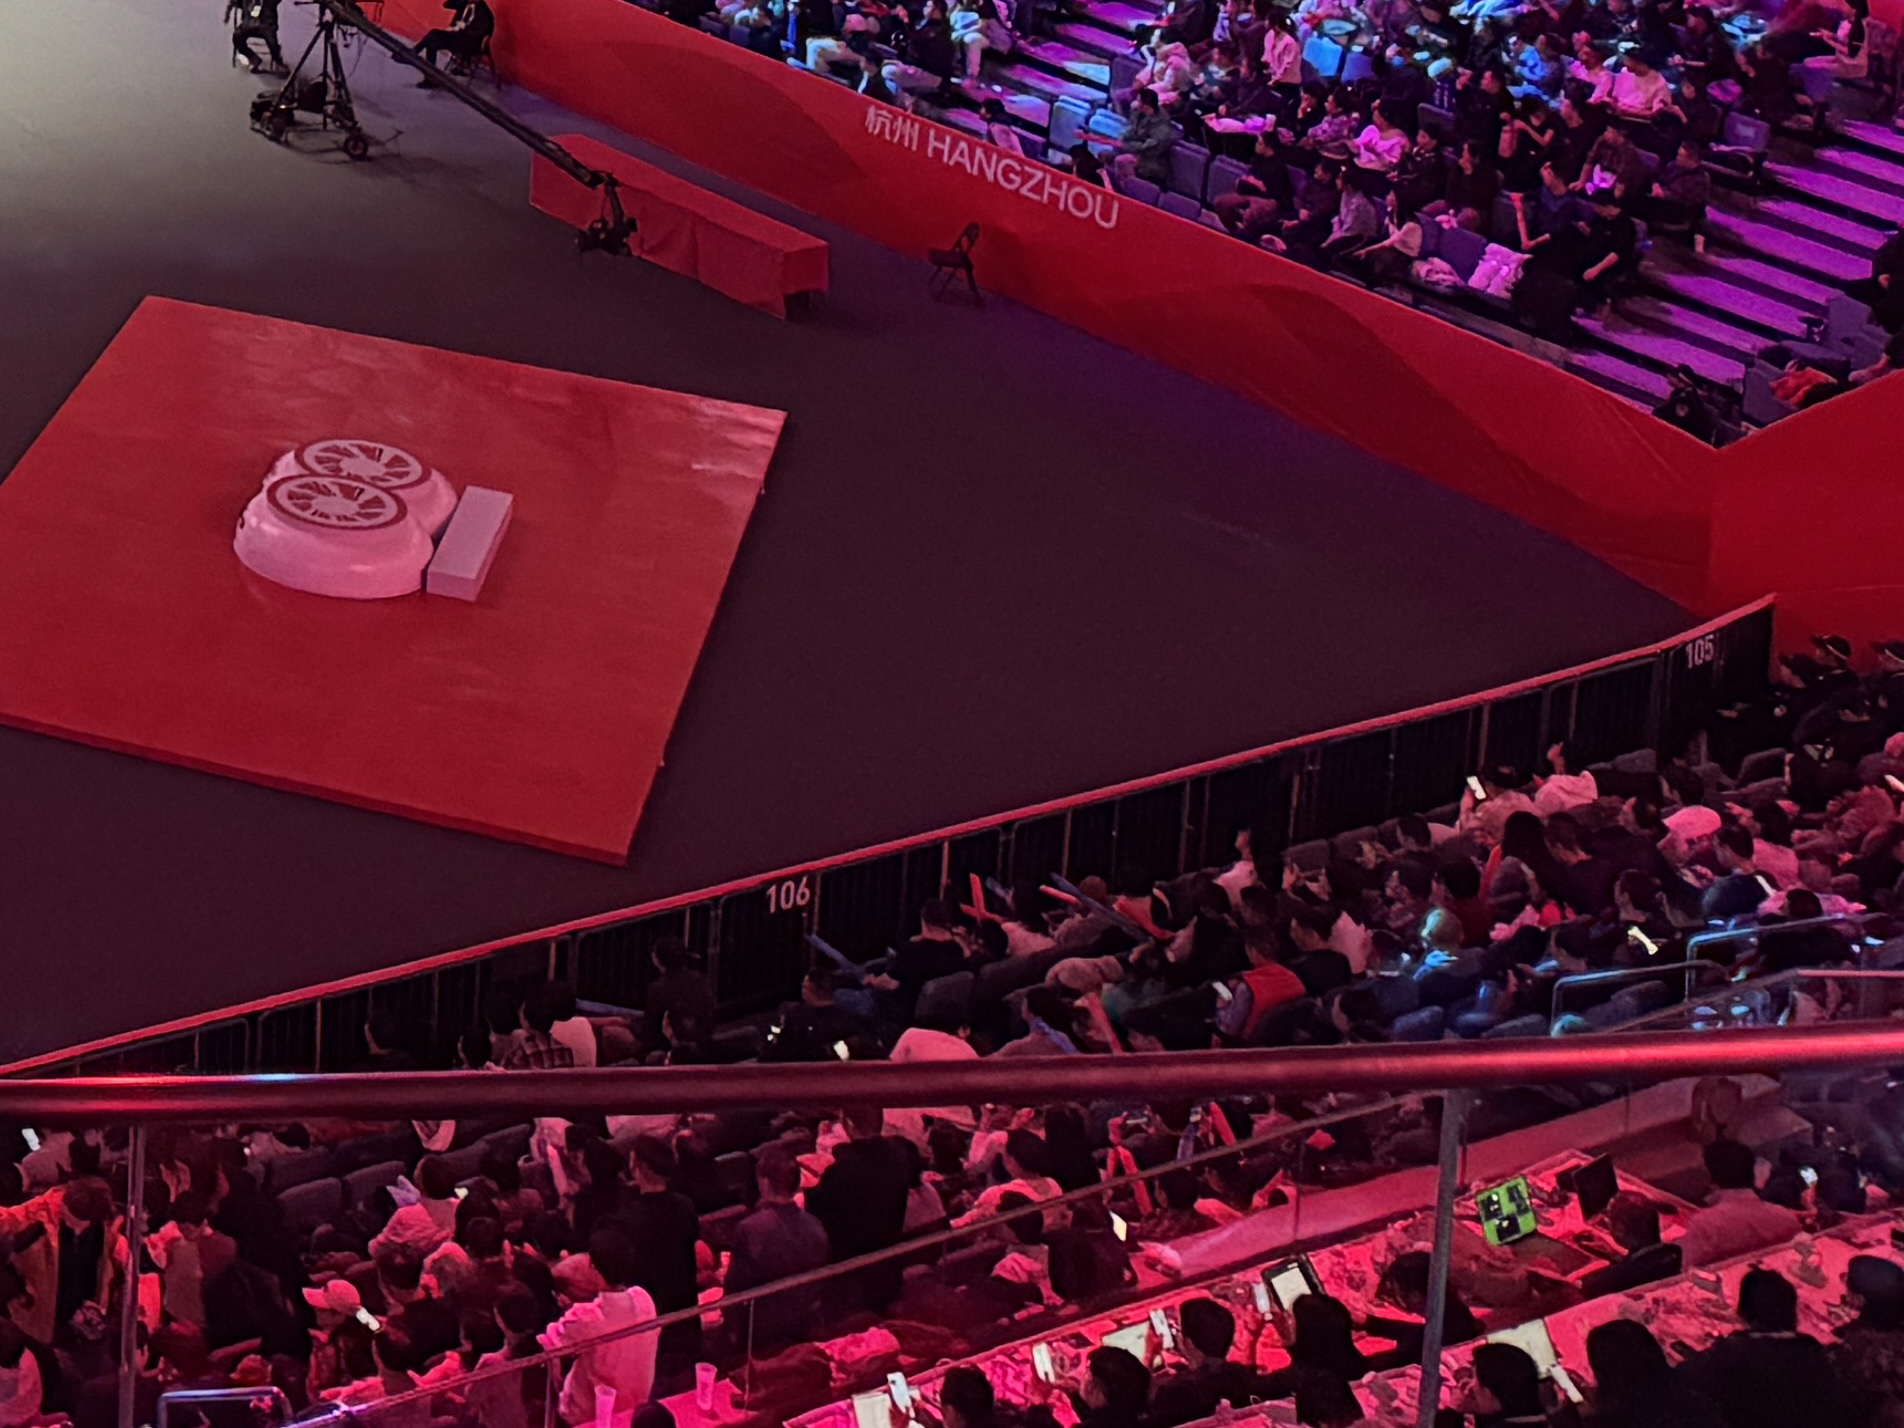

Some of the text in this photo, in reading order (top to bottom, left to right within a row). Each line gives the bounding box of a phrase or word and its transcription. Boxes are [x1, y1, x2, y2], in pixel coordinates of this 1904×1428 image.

[864, 104, 1120, 231] 杭州 HANGZHOU
[1685, 633, 1715, 669] 105
[766, 875, 811, 915] 106
